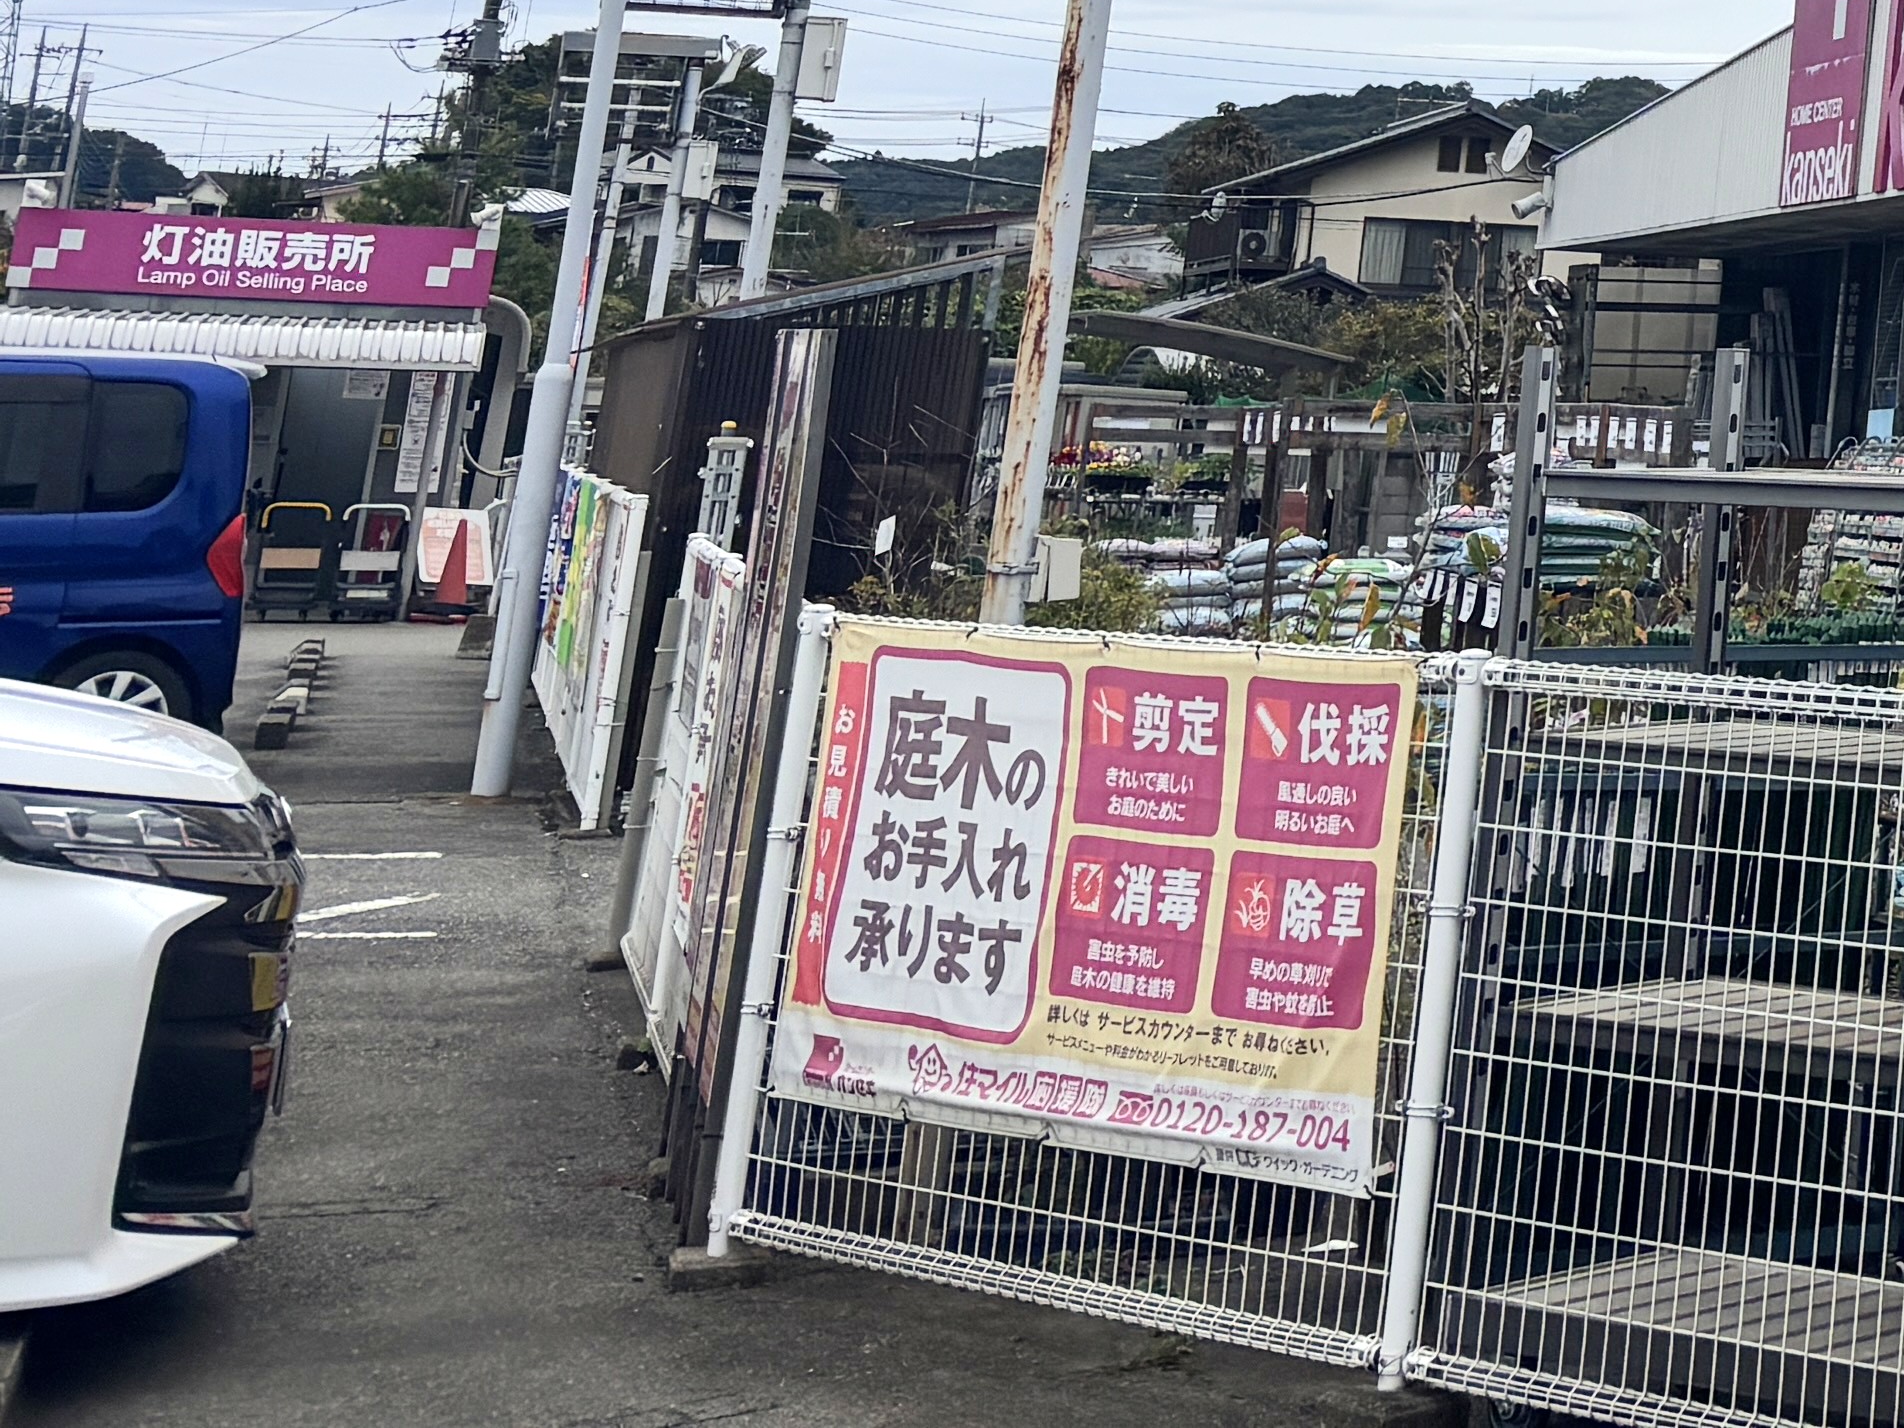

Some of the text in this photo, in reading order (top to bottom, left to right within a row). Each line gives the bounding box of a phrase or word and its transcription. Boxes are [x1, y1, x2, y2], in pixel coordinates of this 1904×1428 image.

[1790, 97, 1844, 126] HOME CENTER
[1780, 118, 1855, 207] kanseki
[140, 223, 376, 274] 灯油販売所
[137, 266, 368, 294] Lamp Oil Selling Place
[1131, 691, 1220, 757] 剪定
[1297, 701, 1391, 767] 伐採
[874, 689, 1046, 811] 庭木の
[1105, 766, 1194, 794] きれいで美しい
[1276, 780, 1357, 806] 風通しの良い
[808, 703, 856, 944] お見積り無料
[1107, 794, 1186, 822] お庭のために
[1274, 809, 1355, 837] 明るいお庭へ
[863, 809, 1031, 903] お手入れ
[1110, 860, 1202, 932] 消毒
[1278, 878, 1366, 946] 除草
[844, 899, 1023, 996] 承ります
[1086, 938, 1165, 970] 害虫を予防し
[1070, 964, 1176, 1001] 庭木の健康を維持
[1248, 957, 1334, 988] 早めの草刈りで
[1244, 986, 1335, 1017] 害虫や蚊を防止
[1046, 1004, 1090, 1026] 詳しくは
[1097, 1010, 1238, 1046] サービスカウンターまで
[1150, 1097, 1351, 1153] 0120-187-004
